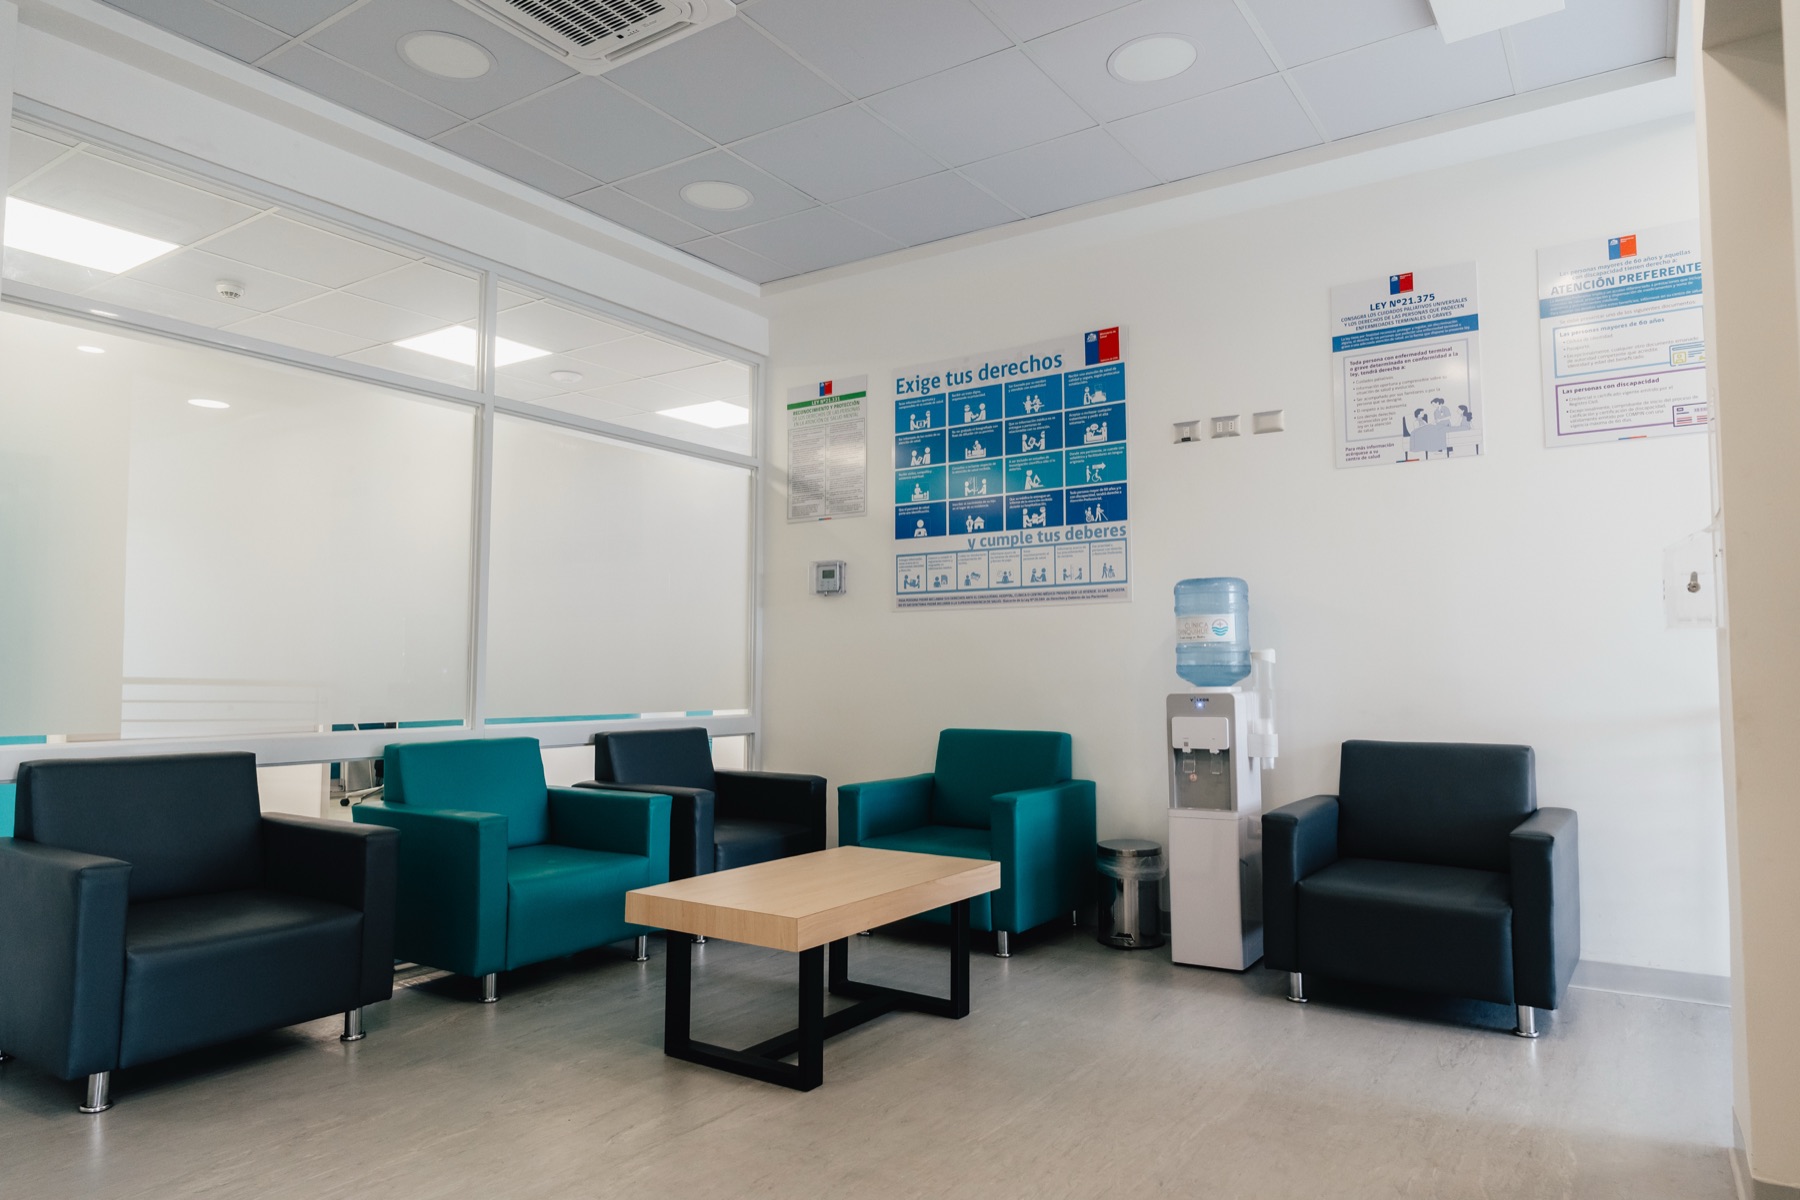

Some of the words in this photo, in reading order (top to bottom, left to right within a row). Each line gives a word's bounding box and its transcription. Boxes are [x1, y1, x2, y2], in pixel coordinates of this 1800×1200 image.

[1571, 267, 1596, 276] personas
[1598, 262, 1623, 270] mayores
[1664, 250, 1690, 259] aquellas
[1584, 267, 1623, 279] discapacidad
[1646, 259, 1670, 268] derecho
[1551, 276, 1615, 296] ATENCIÓN
[1619, 262, 1702, 284] PREFERENTE
[1341, 314, 1366, 322] CONSAGRA
[1377, 308, 1402, 317] CUIDADOS
[1404, 303, 1432, 311] PALIATIVOS
[1433, 297, 1467, 307] UNIVERSALES
[1370, 302, 1386, 311] LEY
[1402, 309, 1428, 317] PERSONAS
[1356, 321, 1394, 331] ENFERMEDADES
[1395, 314, 1426, 324] TERMINALES
[1370, 360, 1403, 368] determinada
[1412, 353, 1447, 363] conformidad
[1395, 350, 1427, 359] enfermedad
[896, 375, 940, 395] Exige
[946, 370, 973, 386] tus
[978, 354, 1062, 381] derechos
[1574, 385, 1602, 394] personas
[1616, 378, 1660, 388] discapacidad
[793, 406, 829, 416] RECONOCIMIENTO
[834, 400, 860, 409] PROTECCIÓN
[968, 536, 976, 550] y
[980, 530, 1033, 548] cumple
[1037, 530, 1061, 543] tus
[1065, 524, 1127, 541] deberes
